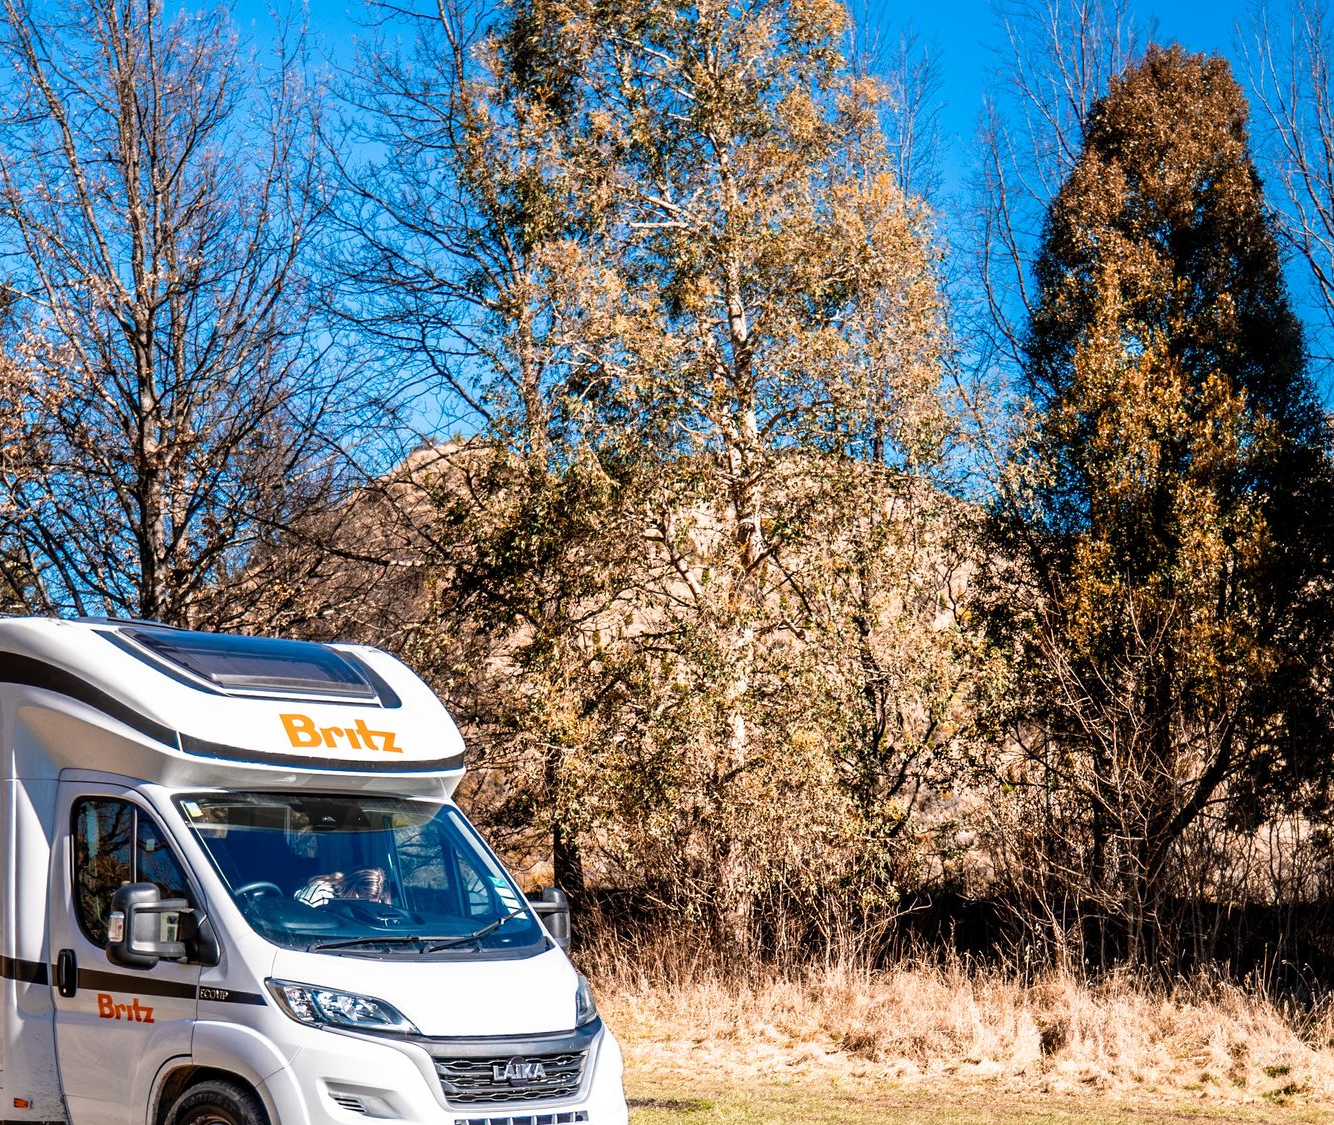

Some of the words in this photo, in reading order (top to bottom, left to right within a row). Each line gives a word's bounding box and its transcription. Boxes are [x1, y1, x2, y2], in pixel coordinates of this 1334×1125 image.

[279, 714, 404, 753] Britz
[98, 993, 155, 1023] Britz
[493, 1063, 546, 1080] LAIKA
